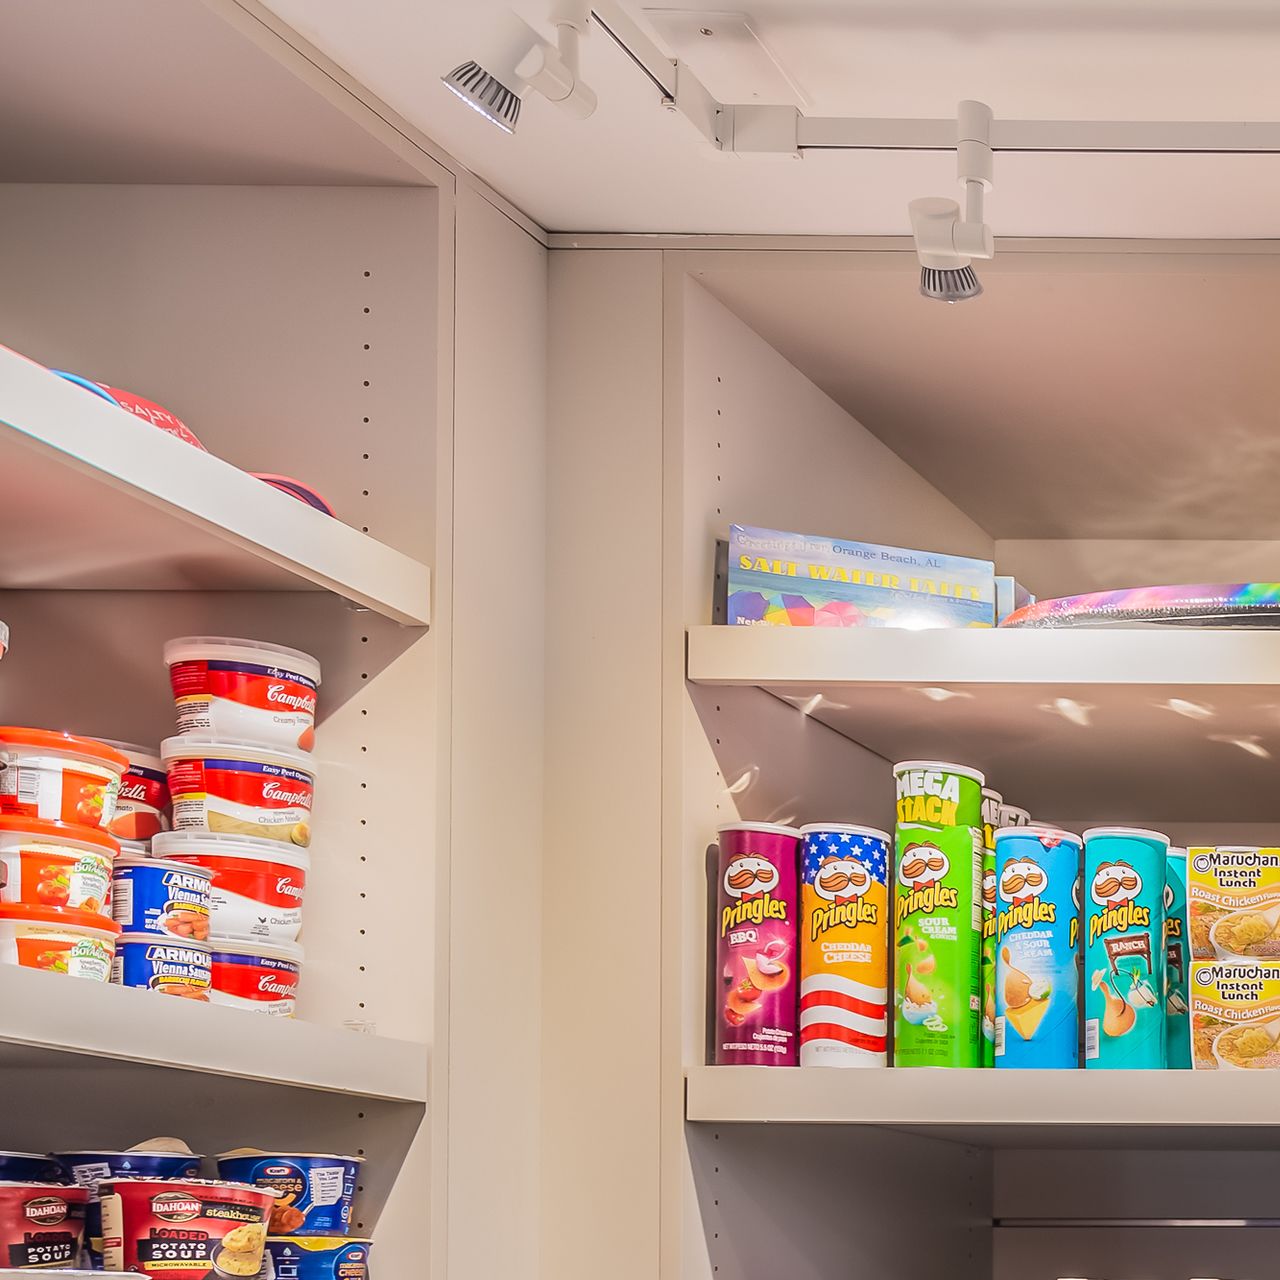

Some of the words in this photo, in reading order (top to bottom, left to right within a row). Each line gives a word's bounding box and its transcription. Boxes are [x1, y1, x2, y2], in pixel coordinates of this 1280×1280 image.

[832, 543, 877, 560] Orange
[881, 551, 922, 566] Beach,
[925, 559, 940, 568] AL
[739, 554, 800, 576] SALT
[808, 564, 899, 590] WATER
[909, 579, 986, 599] TAFFY
[897, 770, 959, 803] MEGA
[897, 796, 957, 825] STACK
[1207, 852, 1280, 867] Maruchan
[1213, 868, 1261, 878] Instant
[1219, 877, 1256, 888] Lunch
[1191, 888, 1220, 901] Roast
[1222, 893, 1263, 906] Chicken
[897, 881, 957, 930] Pringles
[721, 895, 787, 937] Pringles
[811, 898, 878, 941] Pringles
[918, 917, 949, 927] SOUR
[921, 925, 957, 934] CREAM
[997, 902, 1056, 948] Pringles
[1089, 907, 1150, 948] Pringles
[730, 929, 757, 944] BBQ
[821, 942, 871, 952] CHEDDAR
[1110, 939, 1146, 953] RANCH
[823, 952, 871, 963] CHEESE
[152, 960, 188, 975] Vienna
